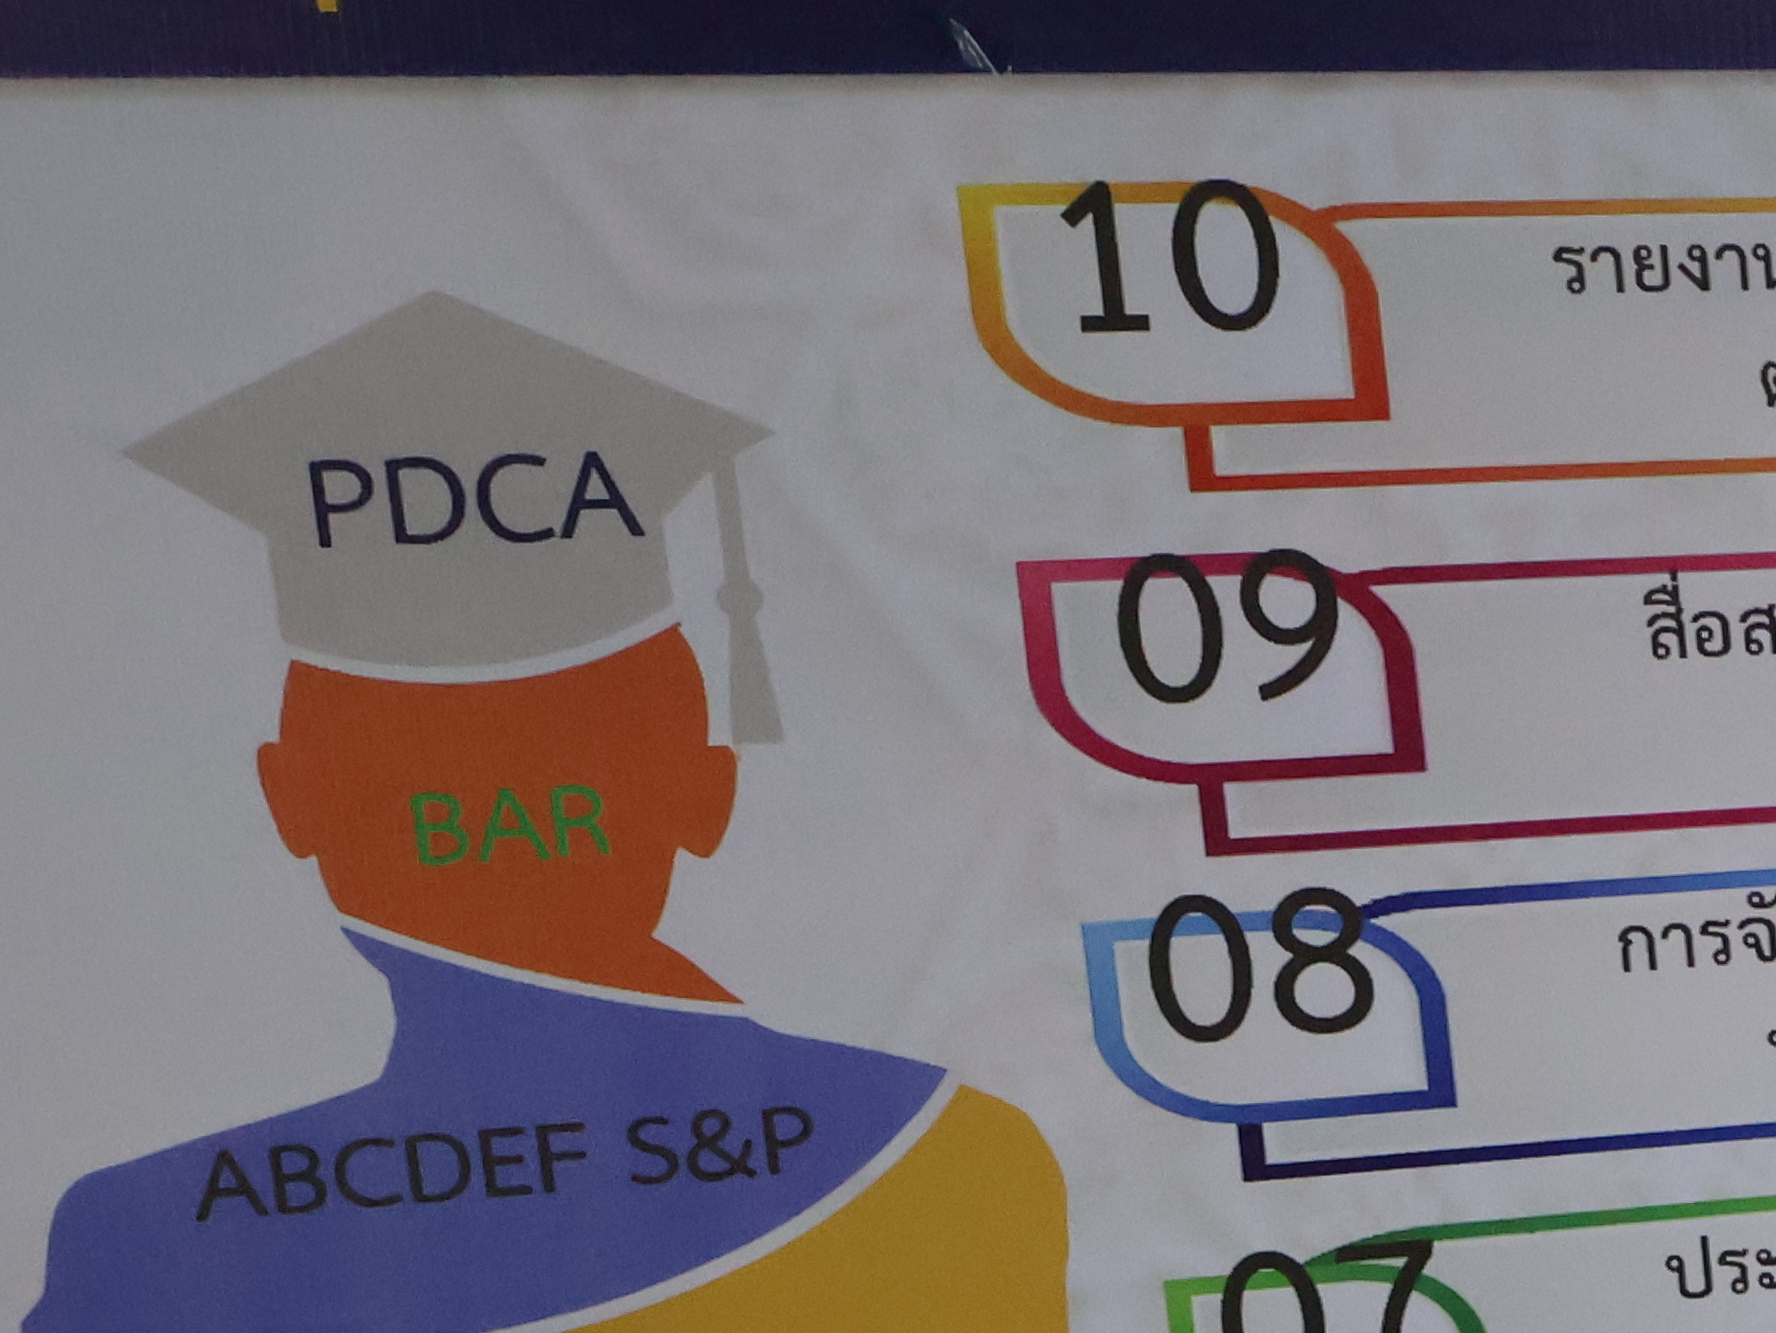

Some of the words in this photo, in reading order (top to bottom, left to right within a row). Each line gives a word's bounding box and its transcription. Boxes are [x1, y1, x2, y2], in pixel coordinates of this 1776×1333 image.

[1060, 178, 1280, 333] 10
[308, 450, 646, 549] PDCA
[1117, 548, 1339, 704] 09
[409, 784, 610, 867] BAR
[1148, 886, 1376, 1043] 08
[196, 1122, 588, 1222] ABCDEF
[627, 1105, 814, 1185] S&P
